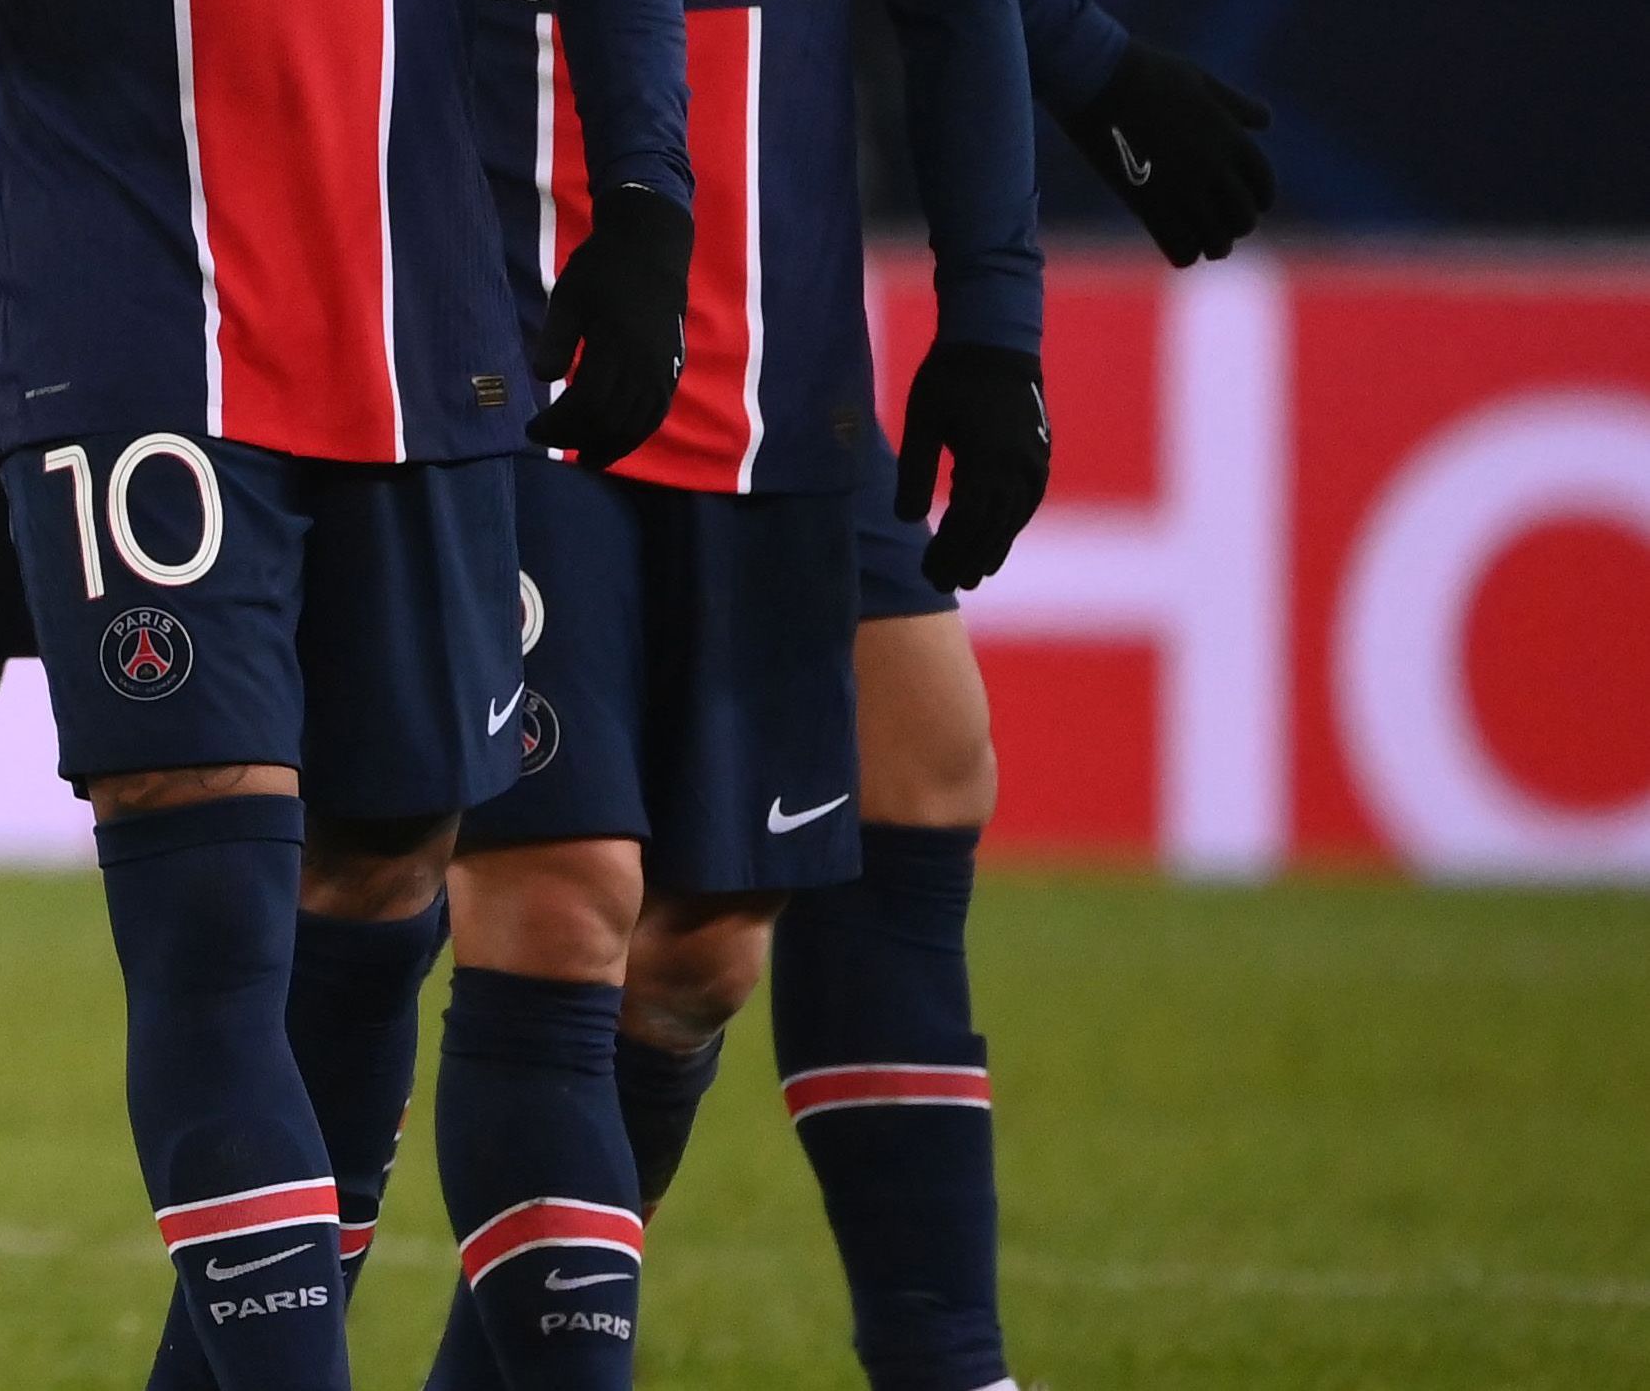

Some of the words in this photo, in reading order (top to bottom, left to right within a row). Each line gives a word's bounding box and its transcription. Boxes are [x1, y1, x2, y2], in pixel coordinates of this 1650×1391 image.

[44, 432, 223, 601] 10
[113, 611, 174, 637] PARIS
[210, 1285, 328, 1325] PARIS
[541, 1312, 632, 1341] PARIS
